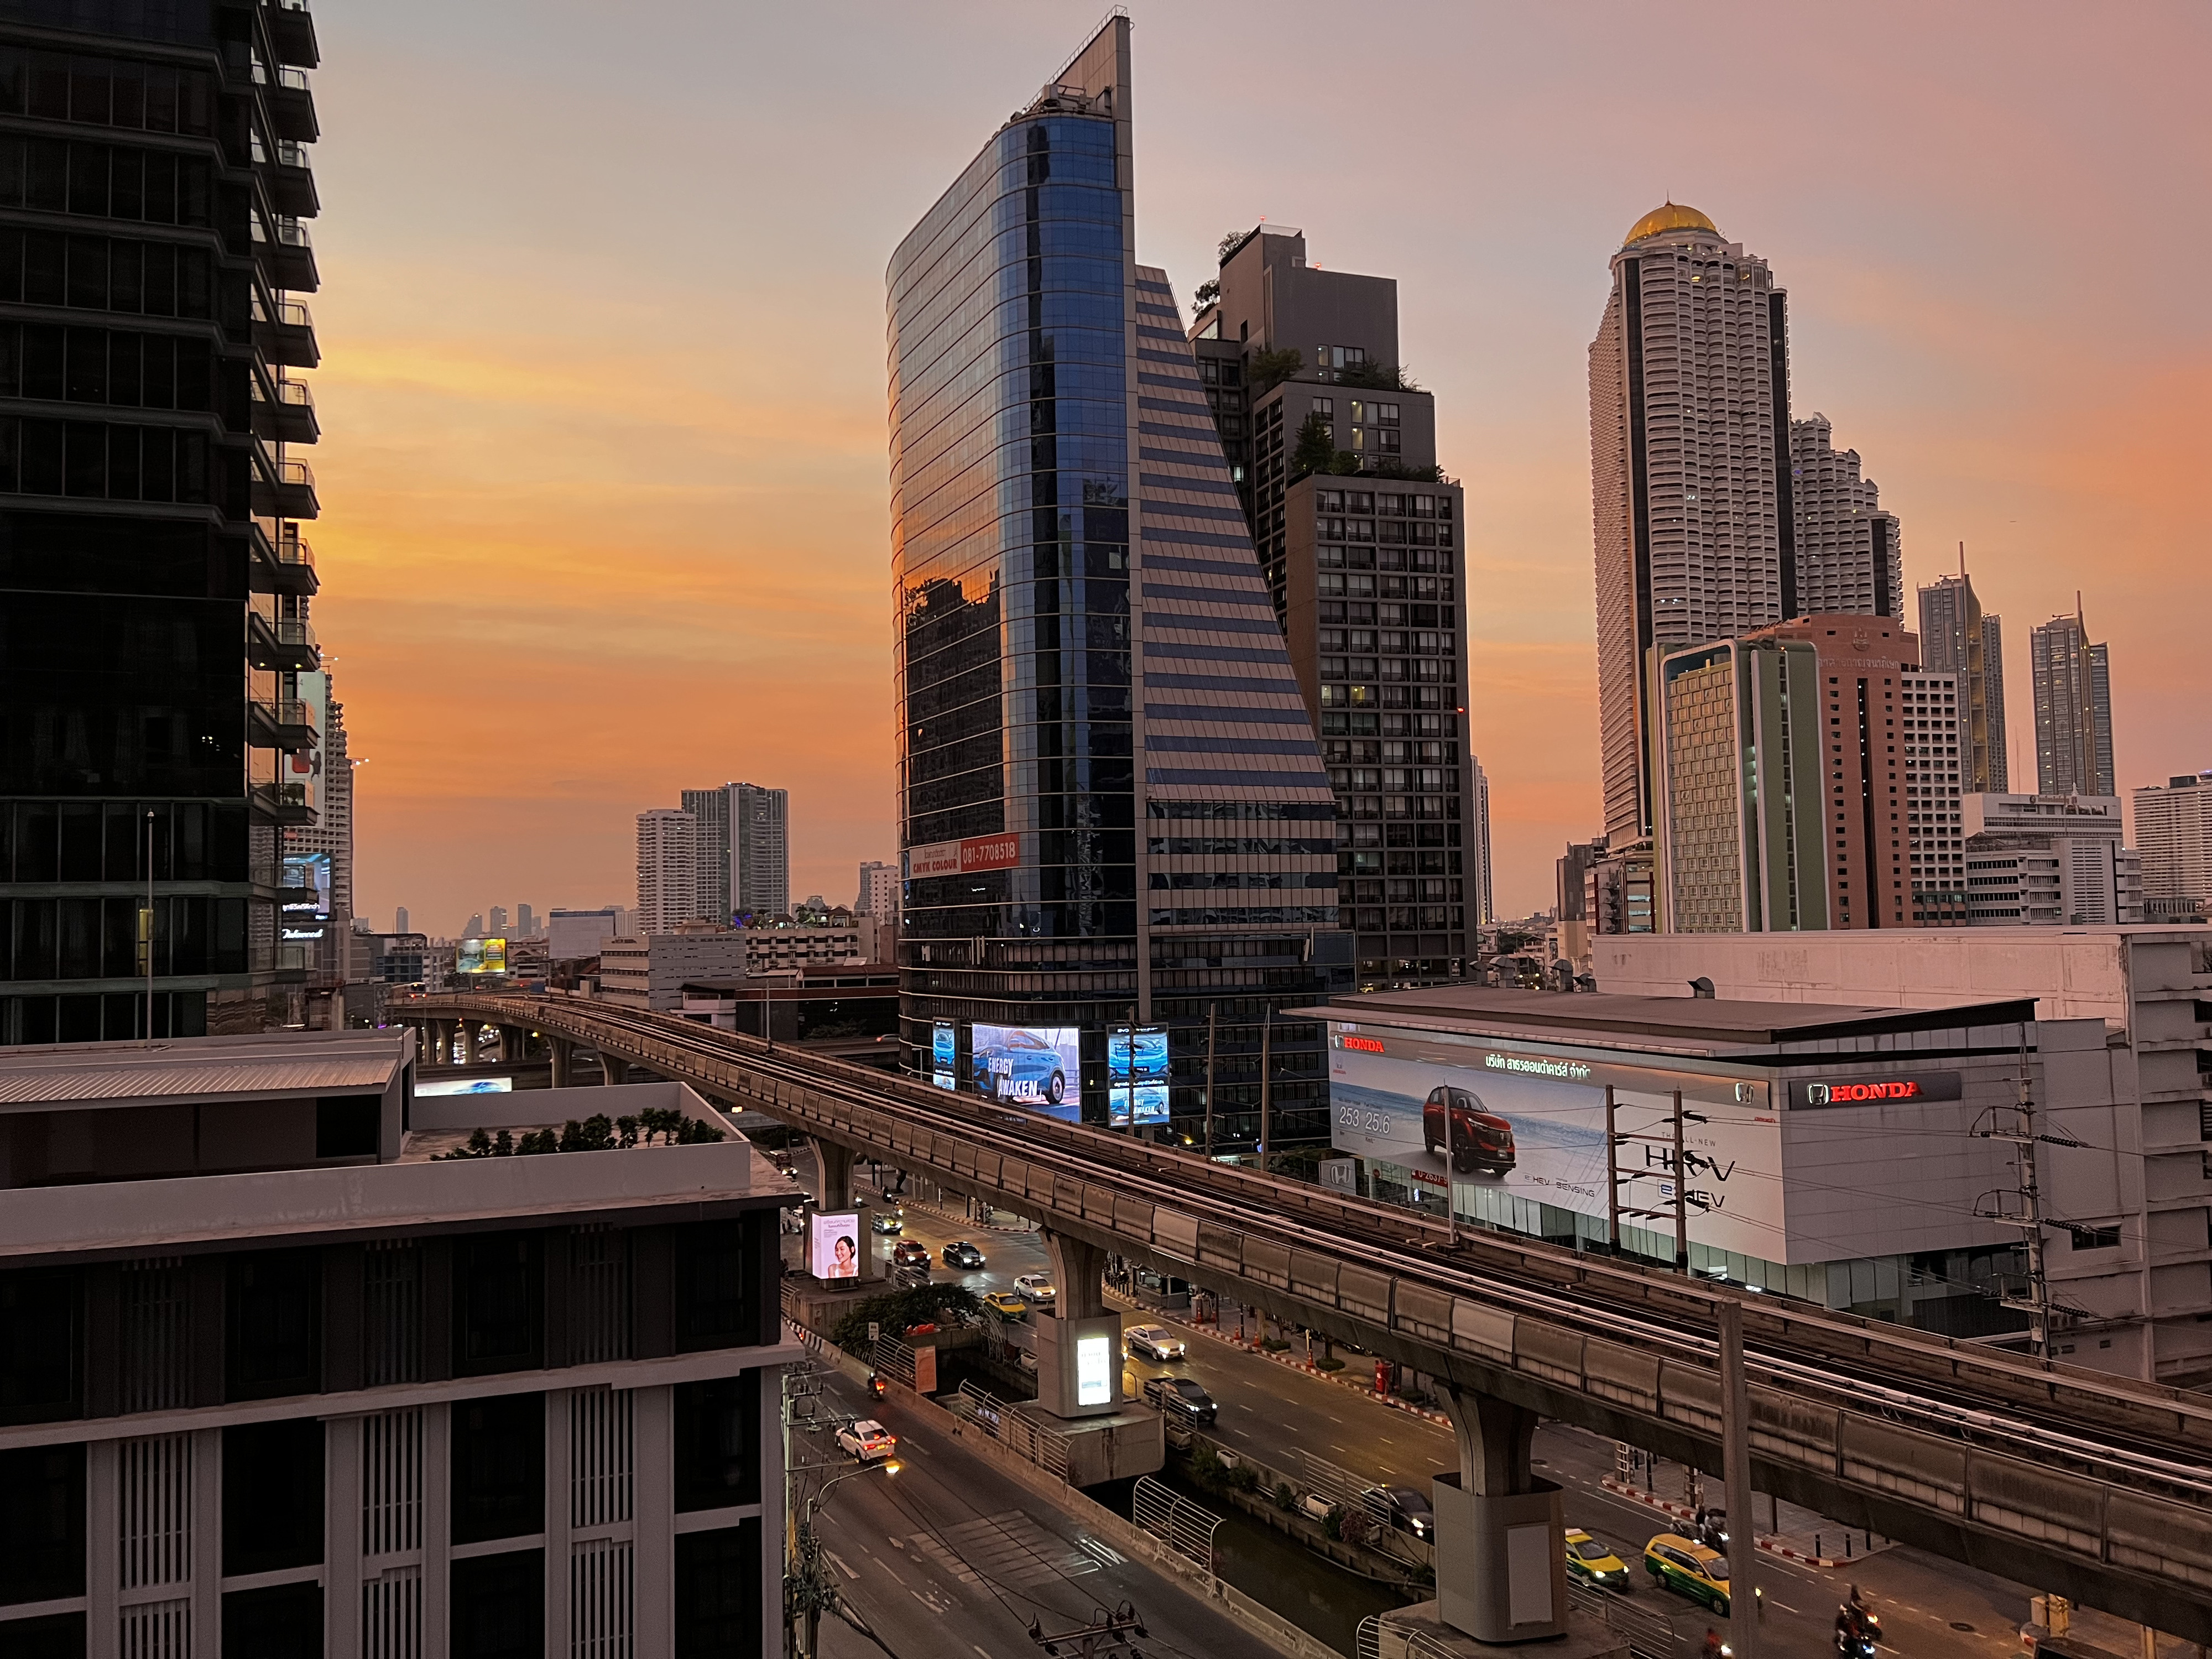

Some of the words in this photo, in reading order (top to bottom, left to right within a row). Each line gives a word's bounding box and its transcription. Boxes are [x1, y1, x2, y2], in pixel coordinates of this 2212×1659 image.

[963, 842, 1016, 864] 081-7708518
[914, 861, 930, 873] CMYK
[932, 858, 957, 871] COLOUR
[1344, 1037, 1384, 1052] HONDA
[988, 1057, 1014, 1077] ENERGY
[1485, 1054, 1505, 1068] บริษัท
[998, 1079, 1038, 1098] AWAKEN
[1830, 1082, 1924, 1102] HONDA
[1339, 1106, 1359, 1127] 253
[1365, 1112, 1390, 1134] 25.6
[1683, 1136, 1716, 1147] LL-NEW
[1556, 1182, 1595, 1197] SENSING
